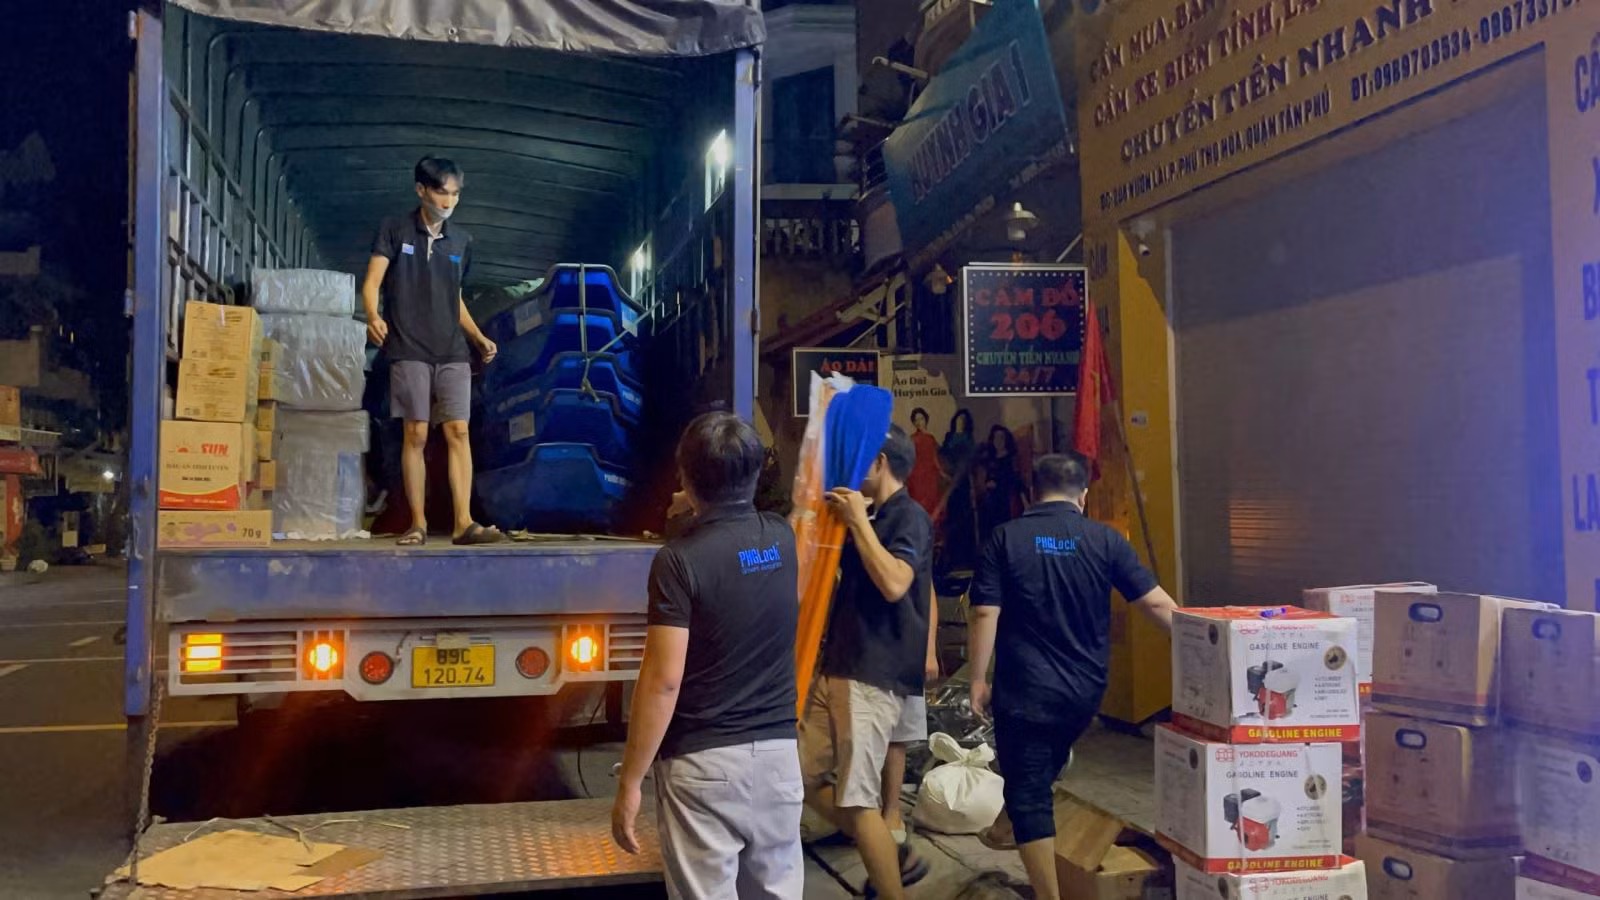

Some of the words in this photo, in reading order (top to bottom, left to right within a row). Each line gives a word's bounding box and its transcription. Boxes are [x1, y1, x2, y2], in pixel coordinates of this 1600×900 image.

[1298, 0, 1435, 77] NHANH
[989, 308, 1067, 340] 206
[201, 443, 229, 456] SUN
[242, 527, 254, 538] 70
[1292, 641, 1320, 650] ENGINE
[424, 667, 485, 684] 120.74
[1302, 728, 1342, 738] ENGINE
[1269, 770, 1299, 778] ENGINE
[1284, 858, 1324, 868] ENGINE
